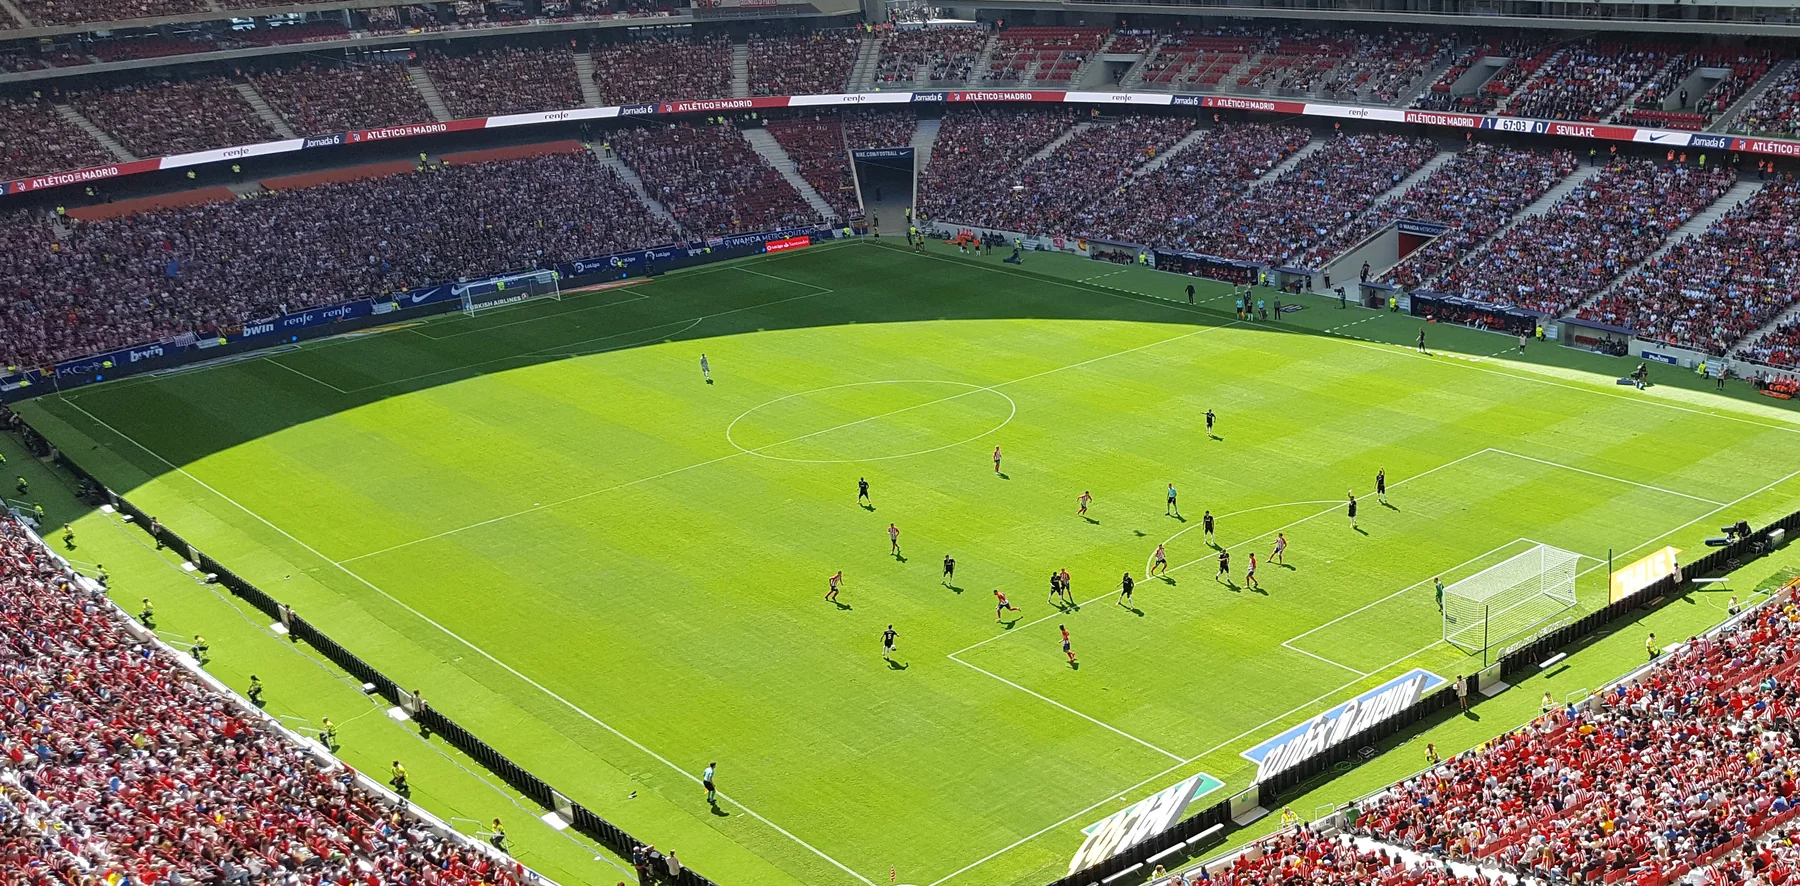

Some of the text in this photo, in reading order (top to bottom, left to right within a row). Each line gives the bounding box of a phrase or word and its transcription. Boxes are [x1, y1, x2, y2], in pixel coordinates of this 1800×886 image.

[843, 94, 866, 104] renfe
[914, 93, 943, 102] Jornada 6
[965, 91, 998, 101] ATLÉTICO
[1004, 92, 1032, 100] MADRID
[1112, 94, 1132, 103] renfe
[1173, 95, 1198, 105] Jornada 6
[622, 105, 653, 116] Jornada 6
[678, 101, 715, 111] ATLÉTICO
[721, 99, 753, 108] MADRID
[1250, 101, 1275, 111] MADRID
[544, 111, 569, 121] renfe
[1348, 108, 1369, 118] renfe
[1406, 112, 1474, 128] ATLÉTICO DE MADRID
[1487, 118, 1492, 129] 1
[367, 127, 406, 140] ATLÉTICO
[413, 123, 447, 134] MADRID
[1503, 121, 1527, 132] 67:03
[1536, 121, 1543, 133] 0
[1556, 124, 1595, 138] SEVILLA FC
[306, 135, 340, 148] Jornada 6
[1691, 136, 1725, 148] Jornada 6
[1752, 140, 1793, 154] ATLÉTICO
[223, 147, 250, 158] renfe
[32, 173, 75, 189] ATLÉTICO
[82, 167, 118, 182] MADRID
[493, 295, 521, 306] AIRLINES
[323, 306, 352, 319] renfe
[284, 313, 313, 327] renfe
[242, 323, 274, 337] bwin
